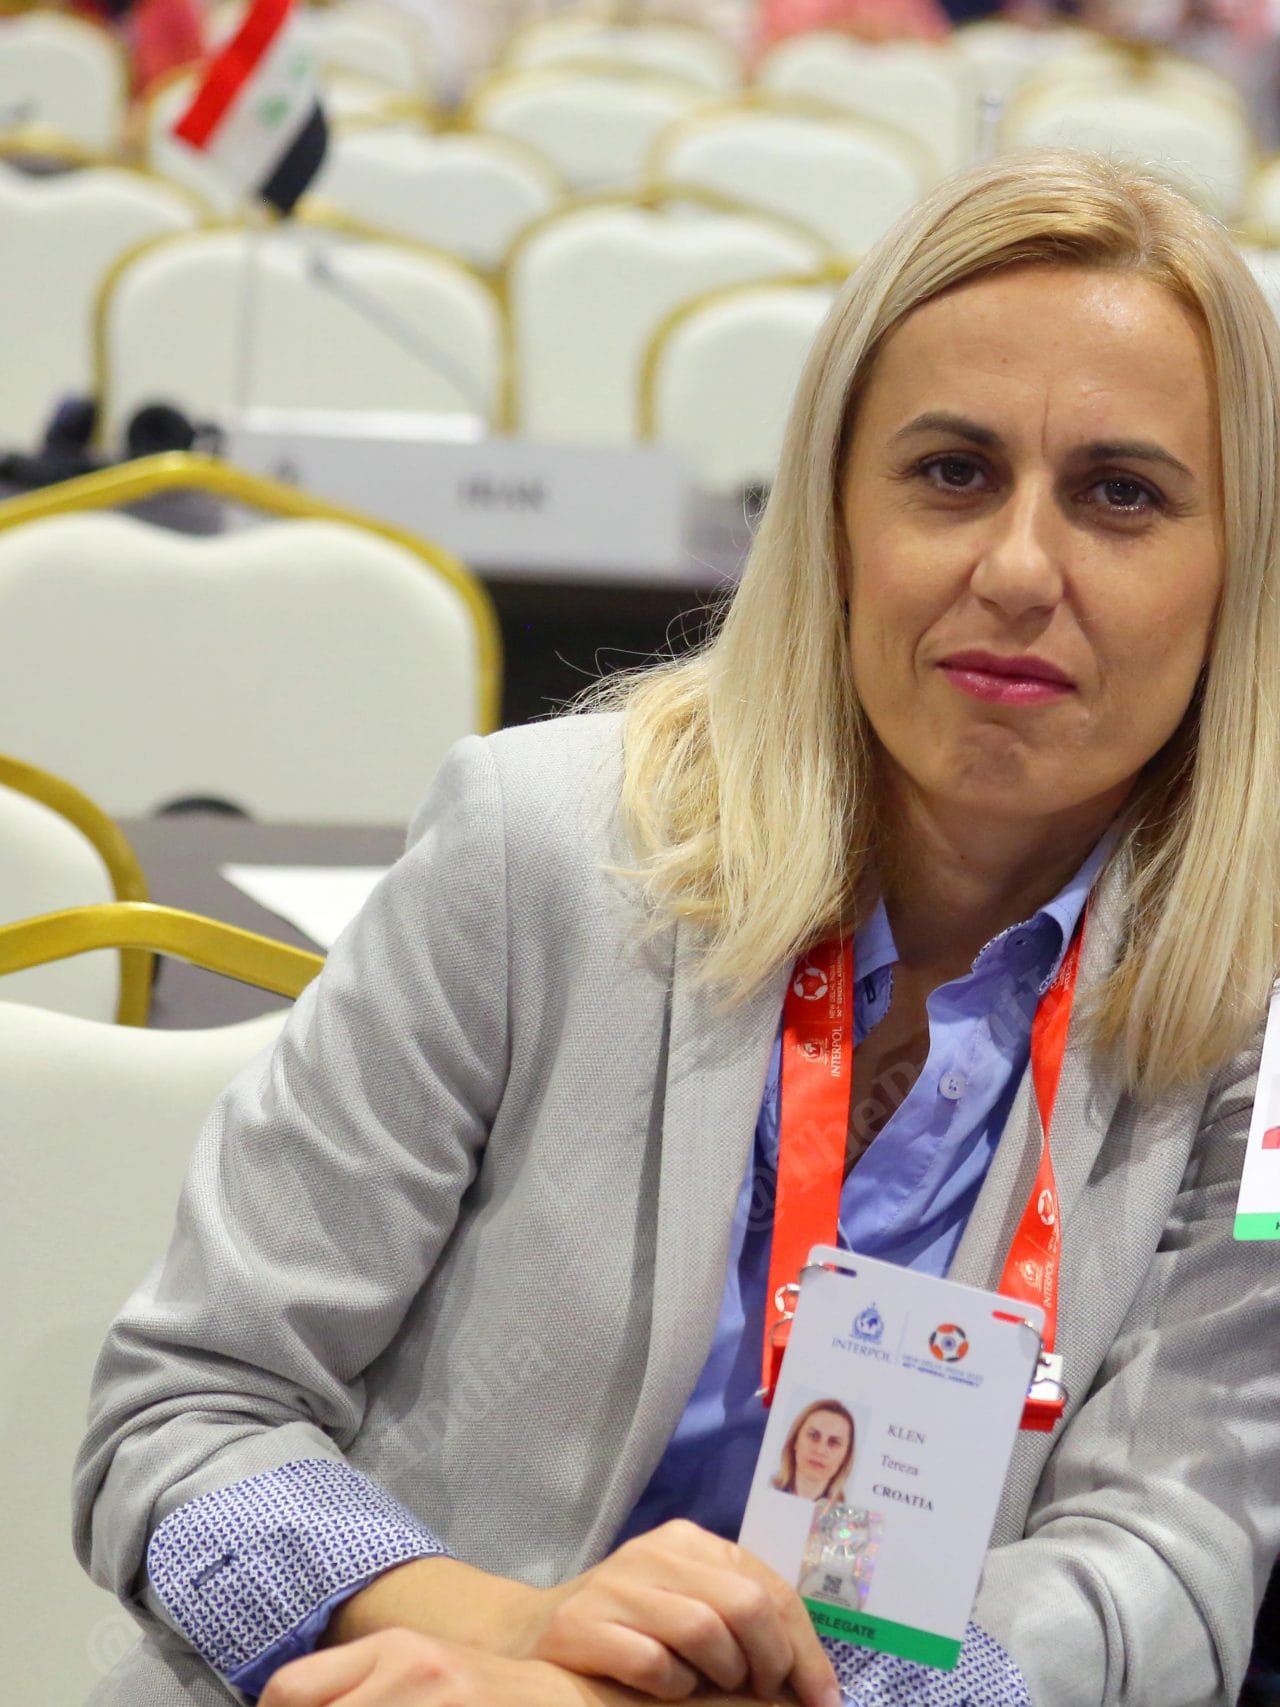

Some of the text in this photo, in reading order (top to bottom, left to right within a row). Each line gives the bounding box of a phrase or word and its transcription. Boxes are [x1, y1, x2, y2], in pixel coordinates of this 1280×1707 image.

[830, 1026, 843, 1078] INTERPOL
[1043, 1261, 1055, 1308] INTERPOL
[832, 1337, 891, 1362] INTERPOL
[888, 1424, 925, 1445] KLEN
[881, 1455, 918, 1476] Tereza
[872, 1484, 933, 1511] CROATIA
[809, 1610, 876, 1640] DELEGATE
